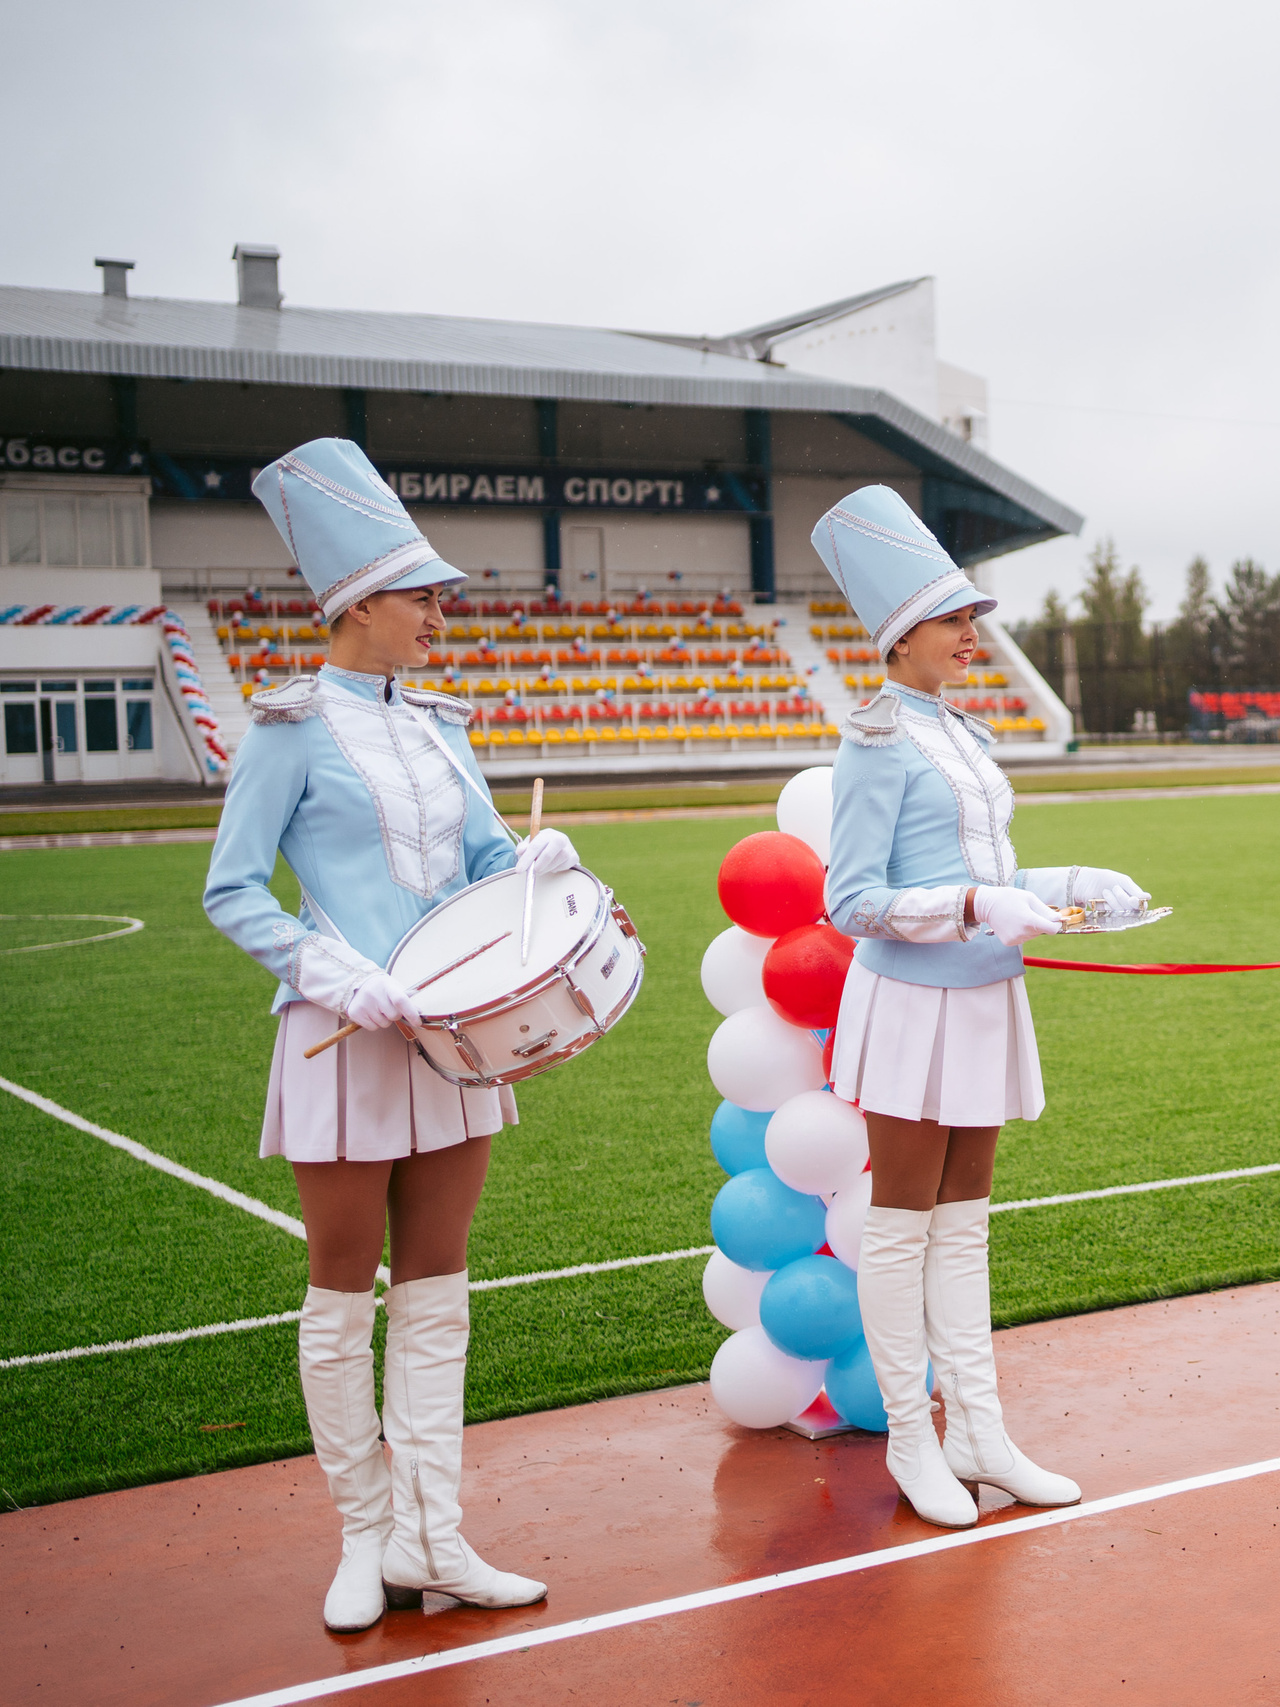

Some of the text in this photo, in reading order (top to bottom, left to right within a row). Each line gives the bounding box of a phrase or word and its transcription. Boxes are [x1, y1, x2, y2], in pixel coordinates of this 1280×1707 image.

[0, 438, 105, 467] басс
[387, 471, 684, 504] БИРАЕМ СПОРТ!
[566, 893, 578, 916] EVANS
